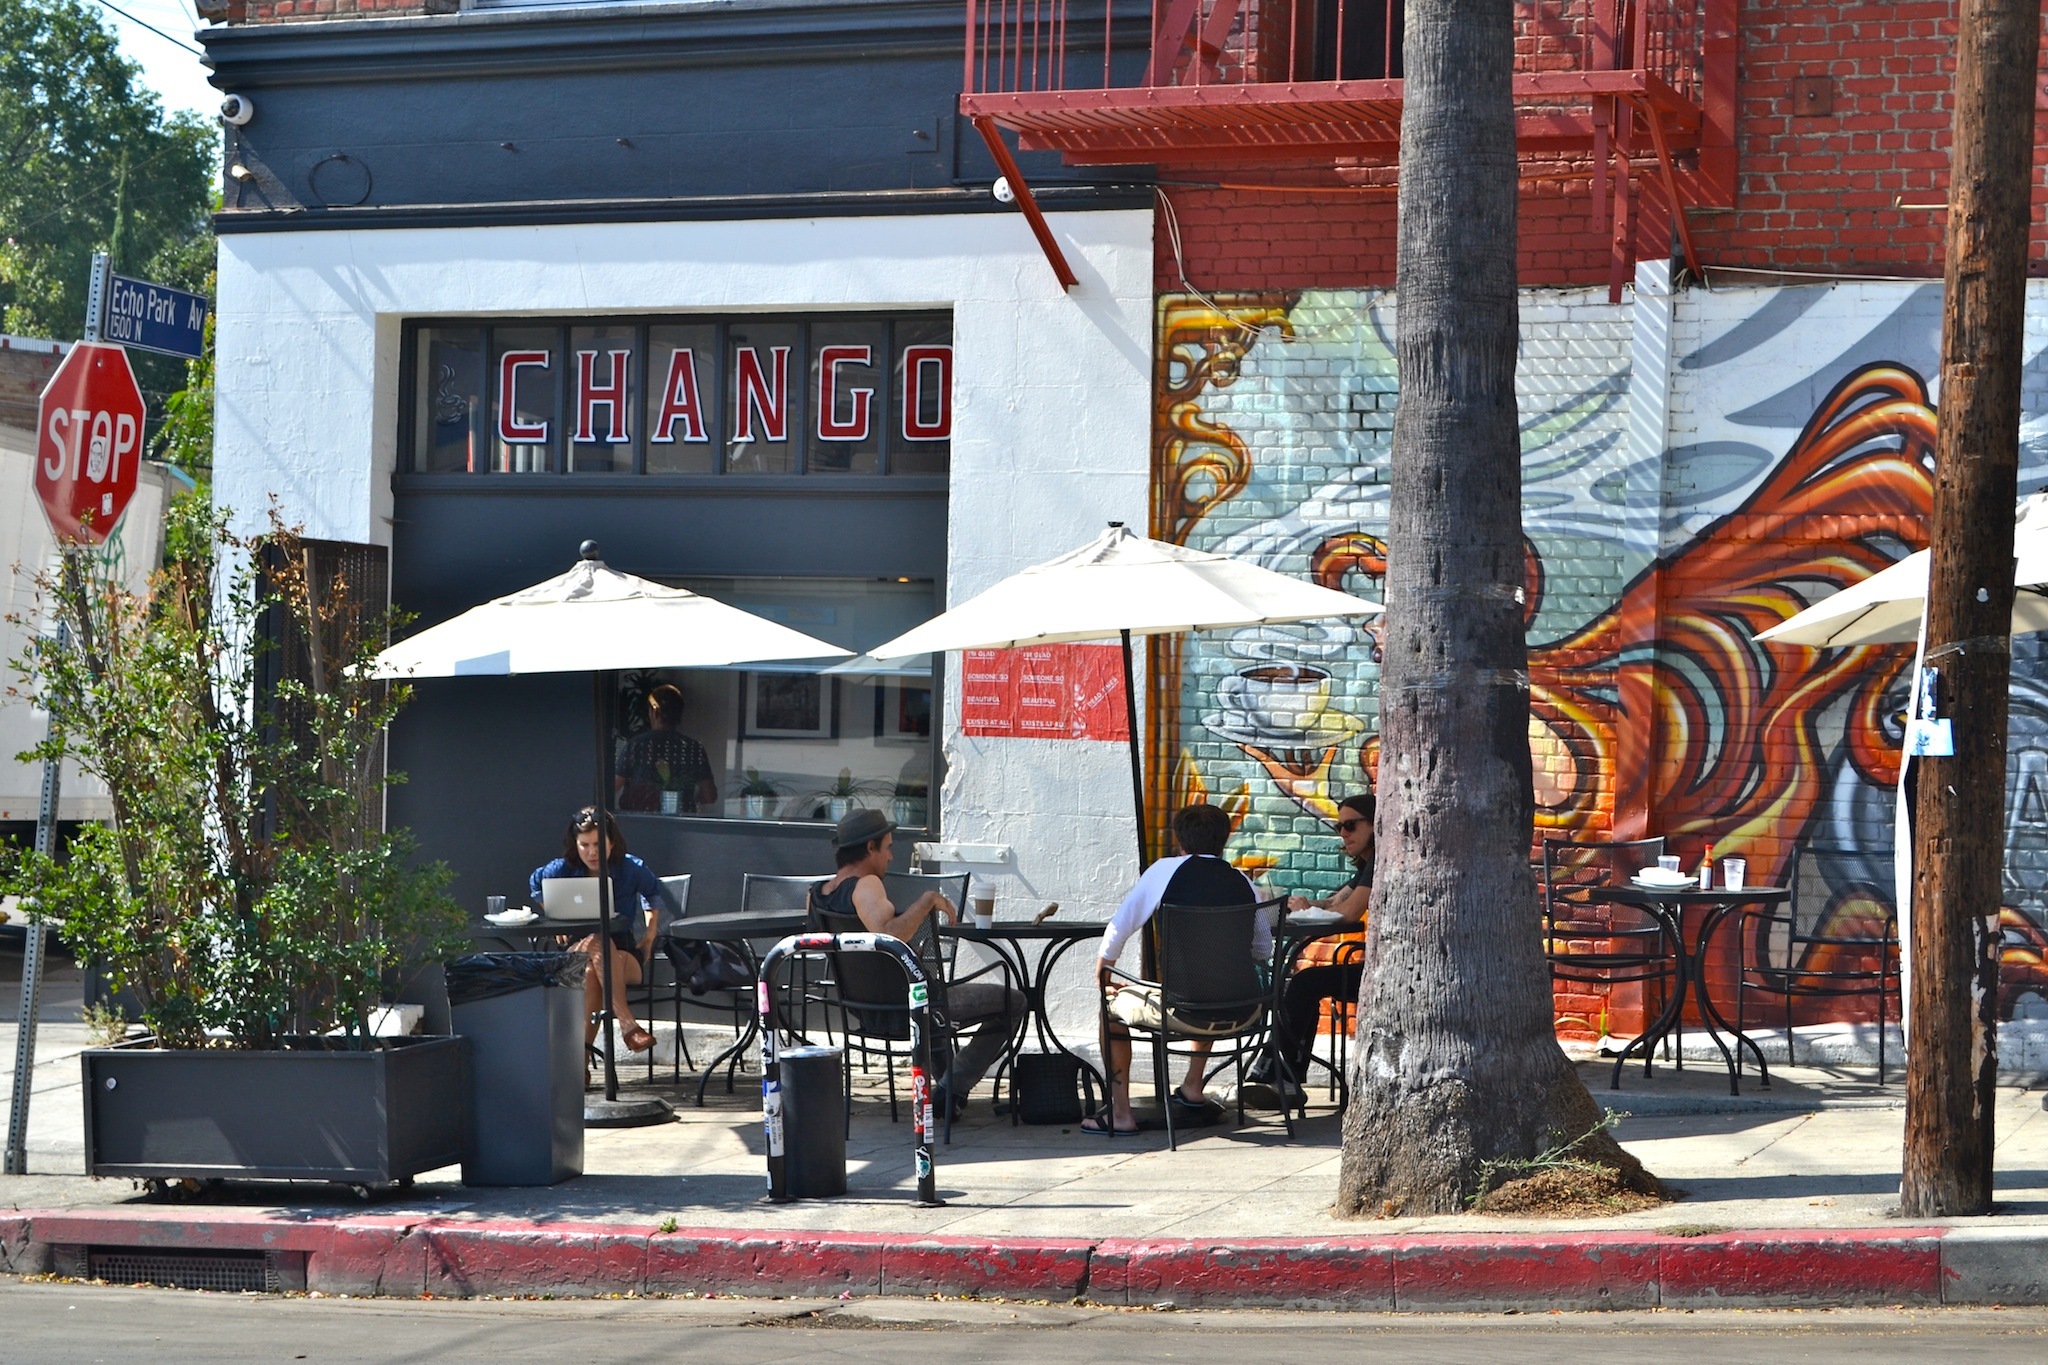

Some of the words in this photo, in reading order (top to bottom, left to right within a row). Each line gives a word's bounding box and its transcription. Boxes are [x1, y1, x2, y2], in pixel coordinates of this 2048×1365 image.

[110, 313, 132, 340] 1500
[134, 319, 143, 342] N
[111, 279, 144, 319] Echo
[146, 288, 176, 326] Park
[187, 298, 203, 331] Av
[498, 344, 953, 443] CHANGO
[44, 406, 136, 484] STOP
[1022, 697, 1056, 705] BEAUTIFUL
